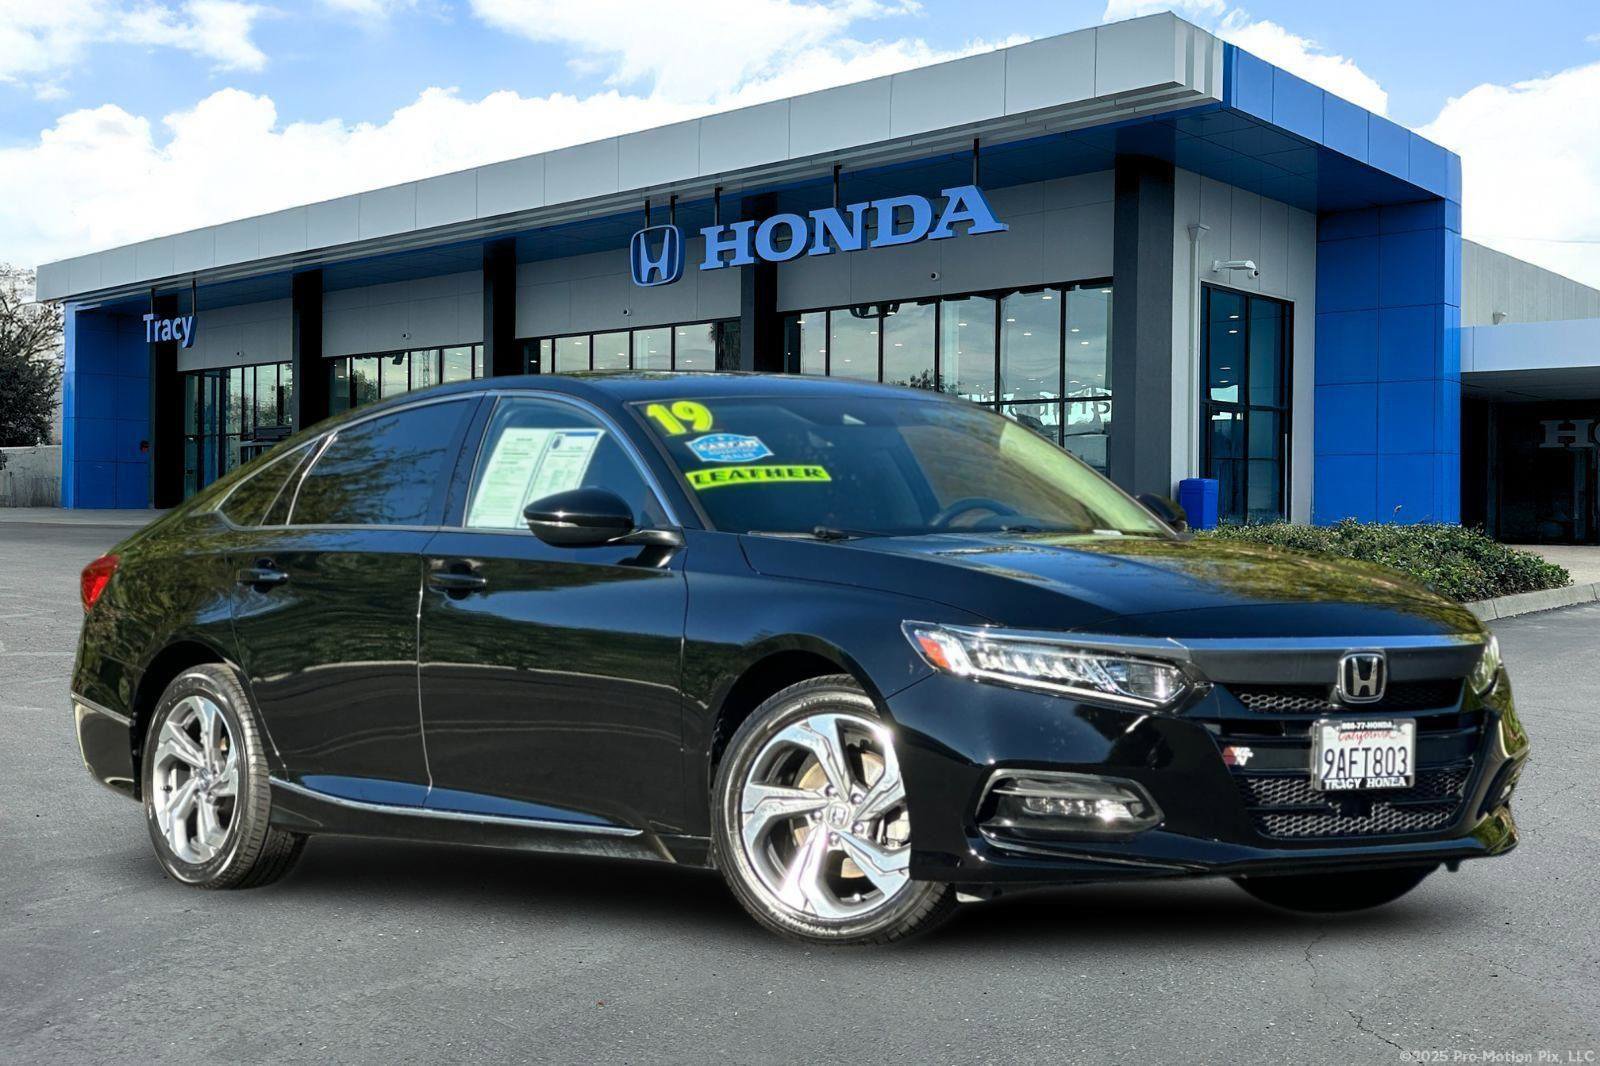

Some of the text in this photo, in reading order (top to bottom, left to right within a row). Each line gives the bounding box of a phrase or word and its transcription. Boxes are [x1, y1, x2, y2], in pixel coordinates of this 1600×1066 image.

[700, 185, 1010, 271] HONDA
[143, 313, 193, 348] Tracy
[646, 401, 714, 435] 19
[1539, 419, 1600, 448] H
[693, 468, 822, 485] LEATHER
[1323, 746, 1407, 779] 9AFT803
[1324, 779, 1362, 790] TRACY
